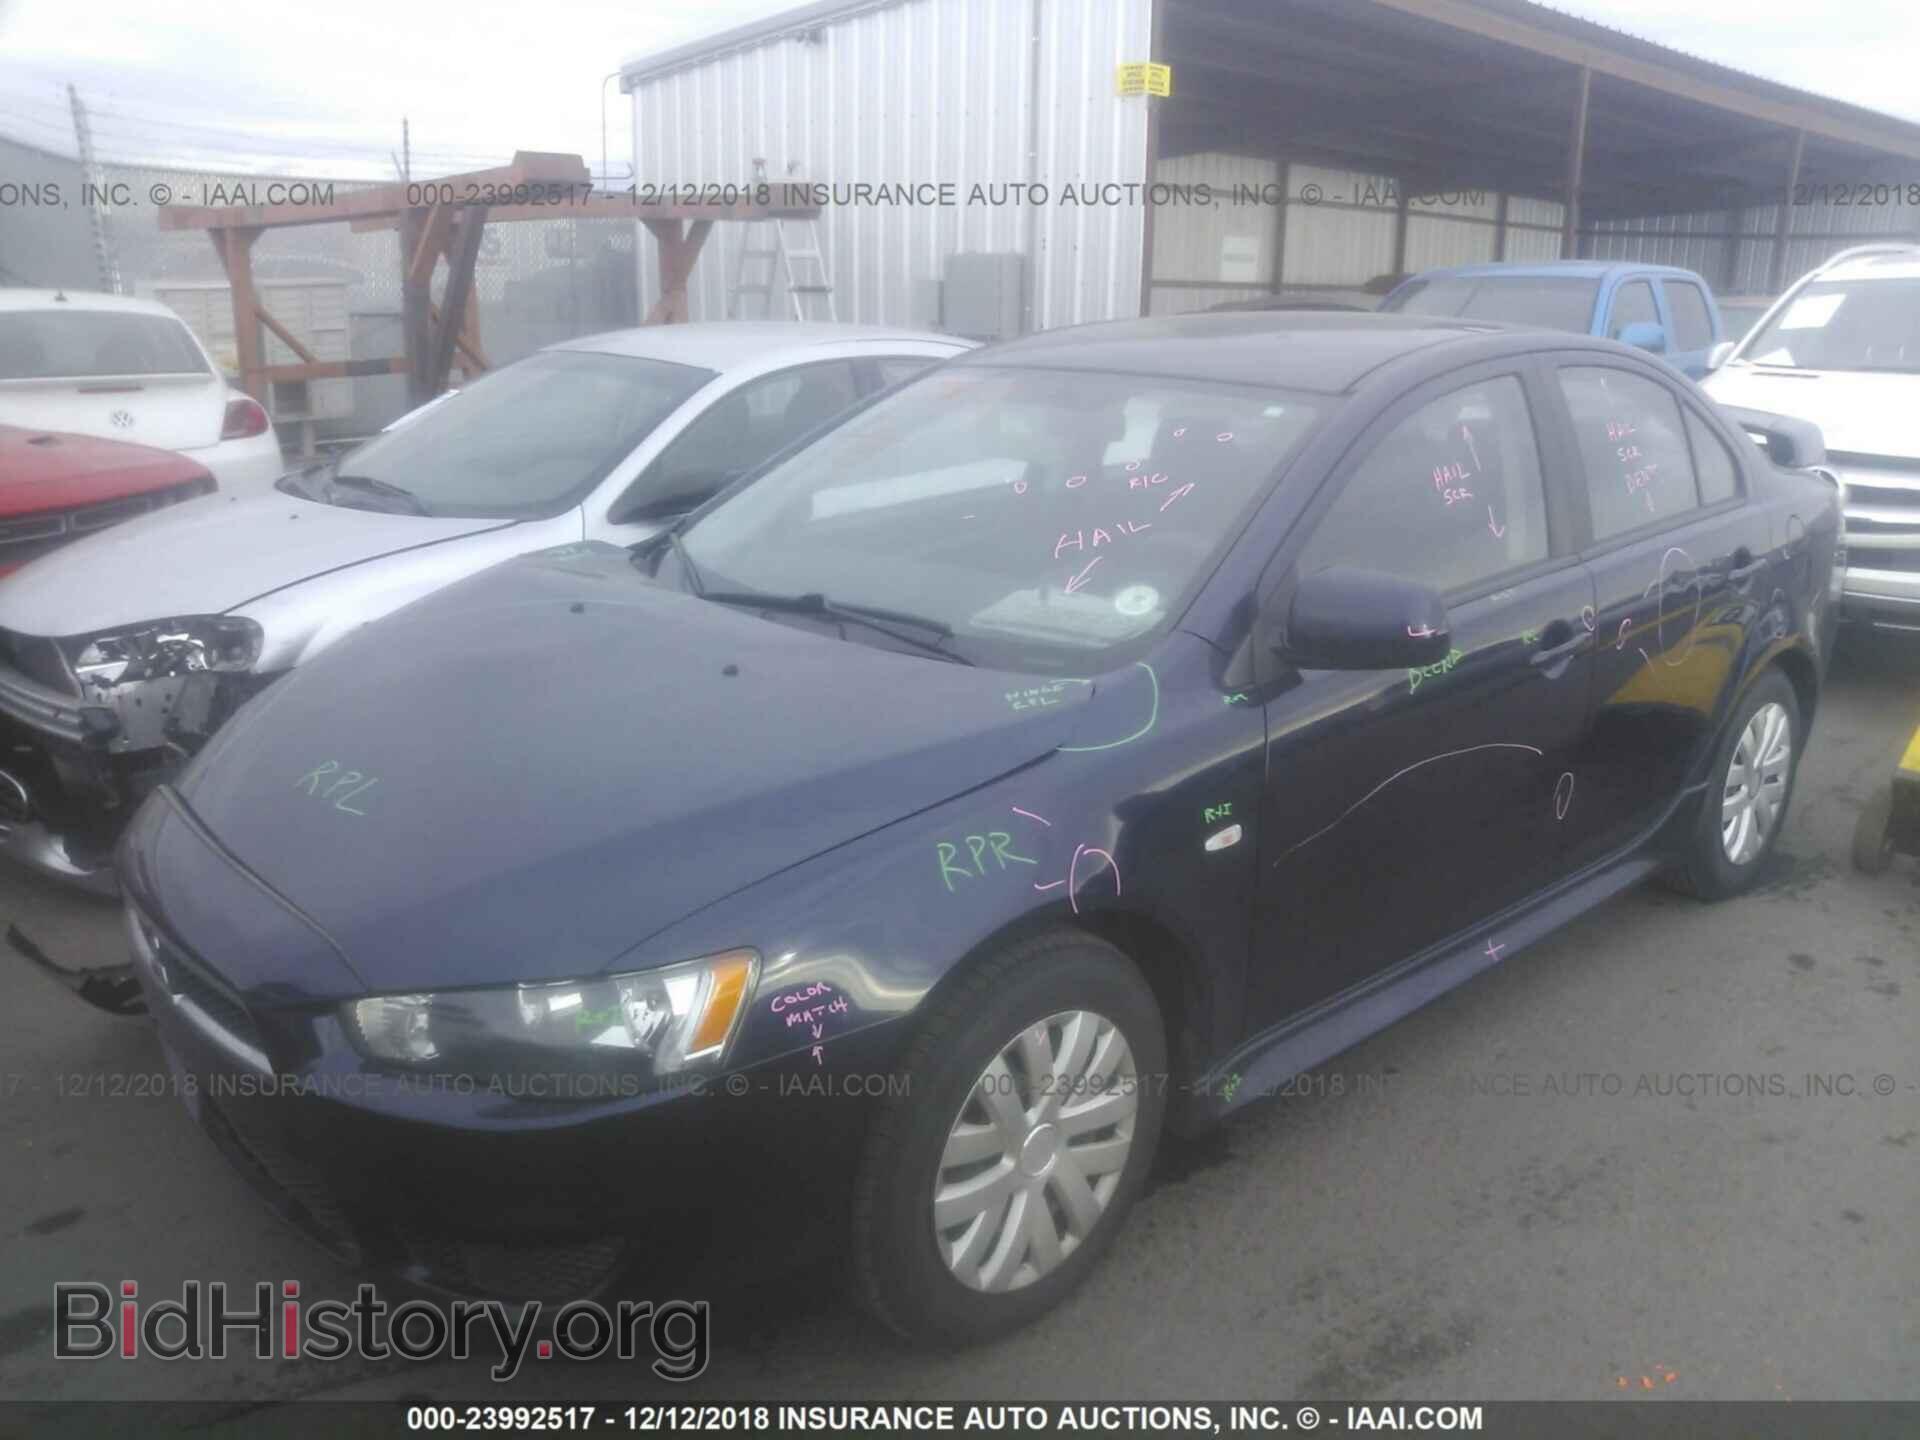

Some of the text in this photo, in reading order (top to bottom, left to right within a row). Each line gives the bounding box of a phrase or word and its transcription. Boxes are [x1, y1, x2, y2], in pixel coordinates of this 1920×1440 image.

[1431, 462, 1472, 491] HAIL
[1053, 520, 1152, 559] HAIL
[292, 759, 380, 816] RPL
[936, 831, 1039, 892] RPR
[770, 981, 832, 1013] COLOR
[786, 995, 848, 1028] MATCH
